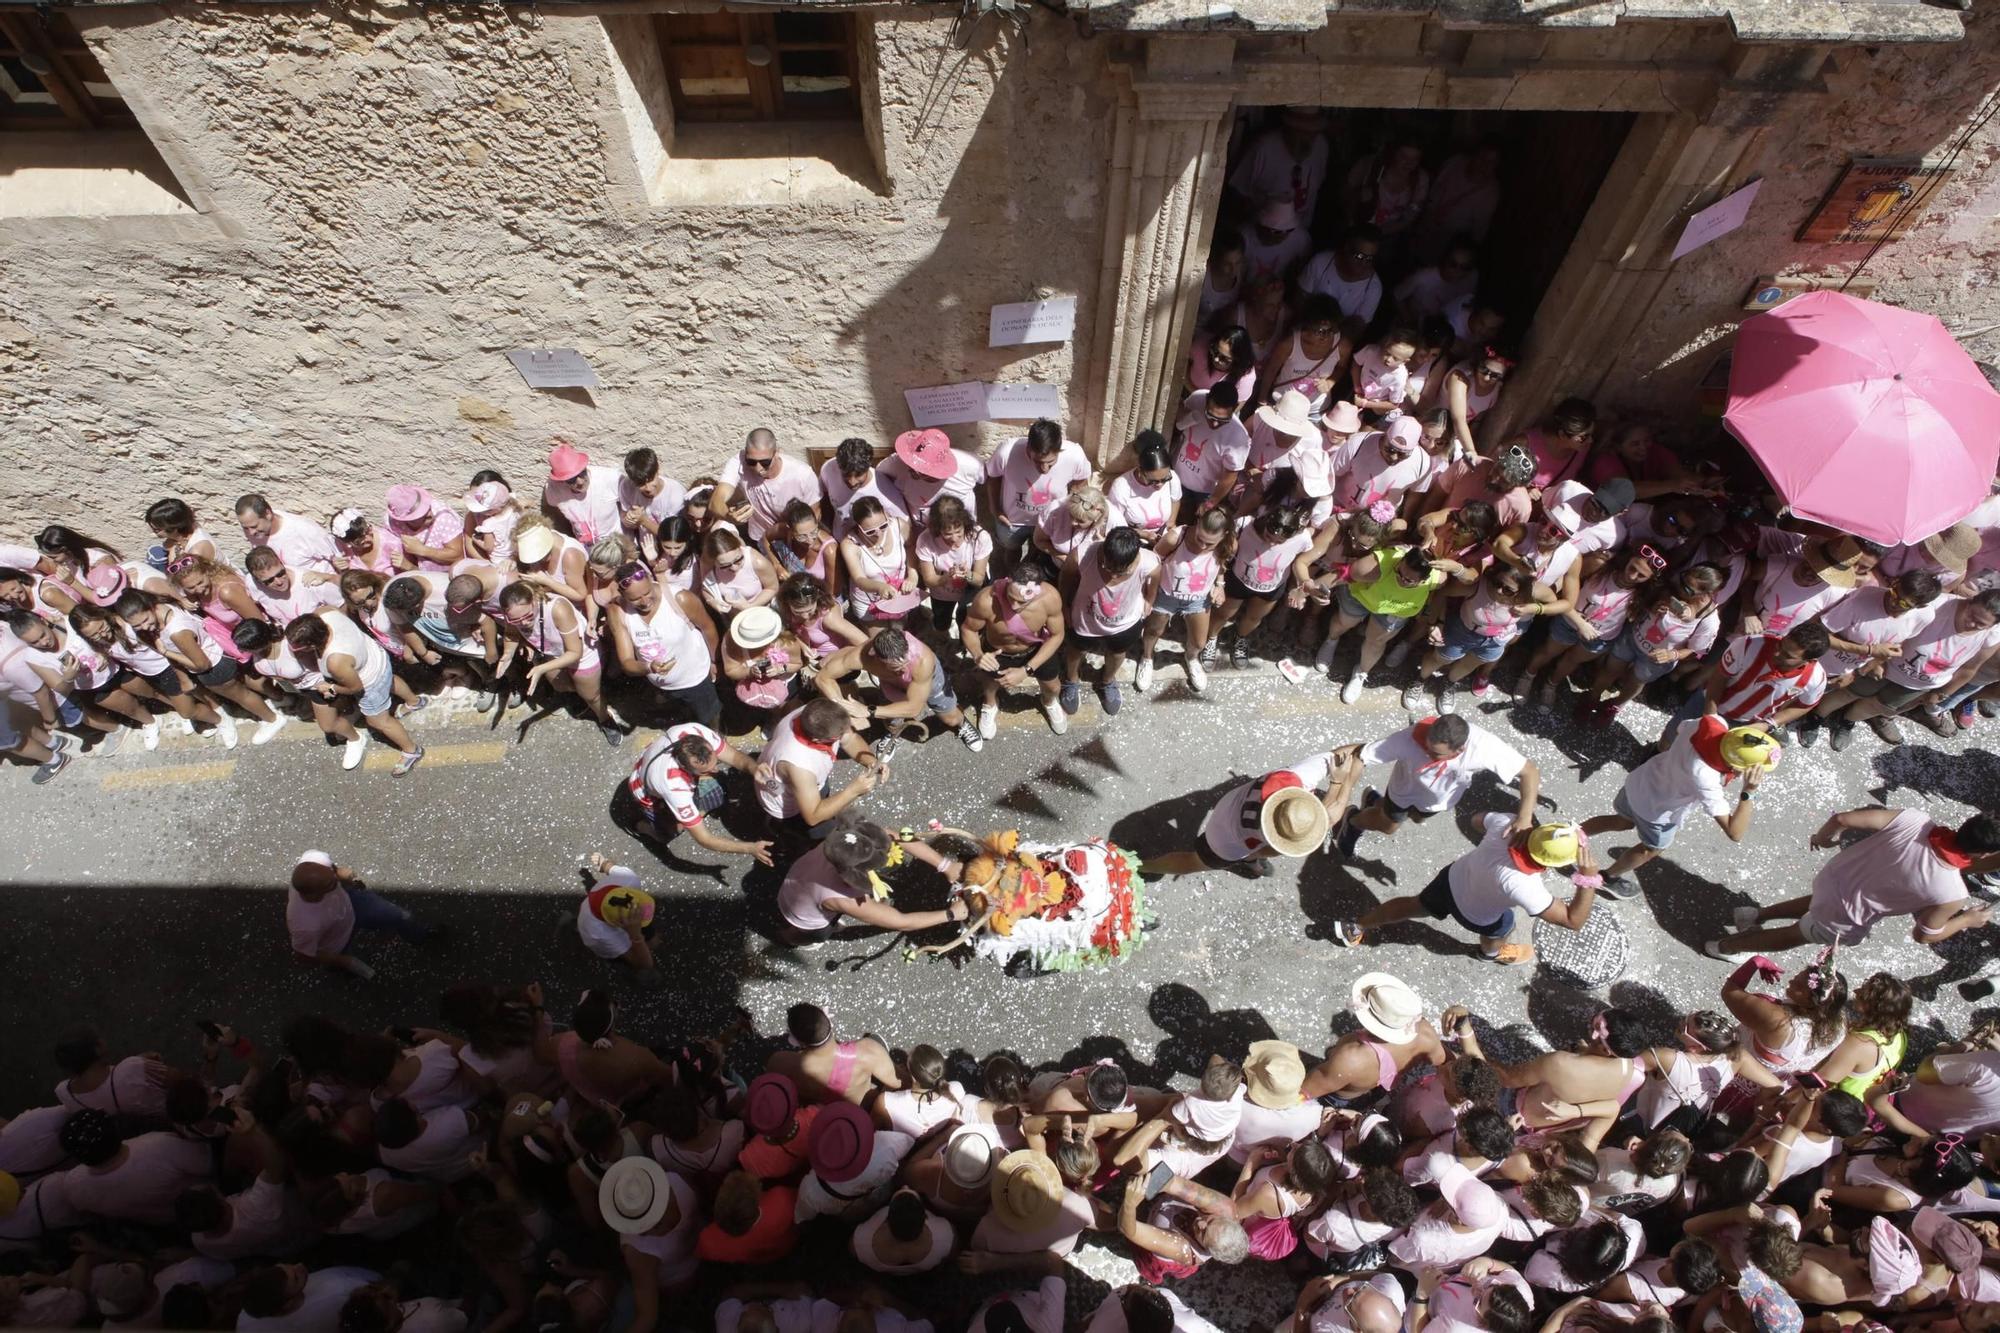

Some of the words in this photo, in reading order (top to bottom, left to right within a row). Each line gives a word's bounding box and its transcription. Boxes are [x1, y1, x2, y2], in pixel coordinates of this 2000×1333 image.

[1015, 492, 1027, 502] I
[1174, 576, 1185, 593] I
[1904, 651, 1927, 668] I
